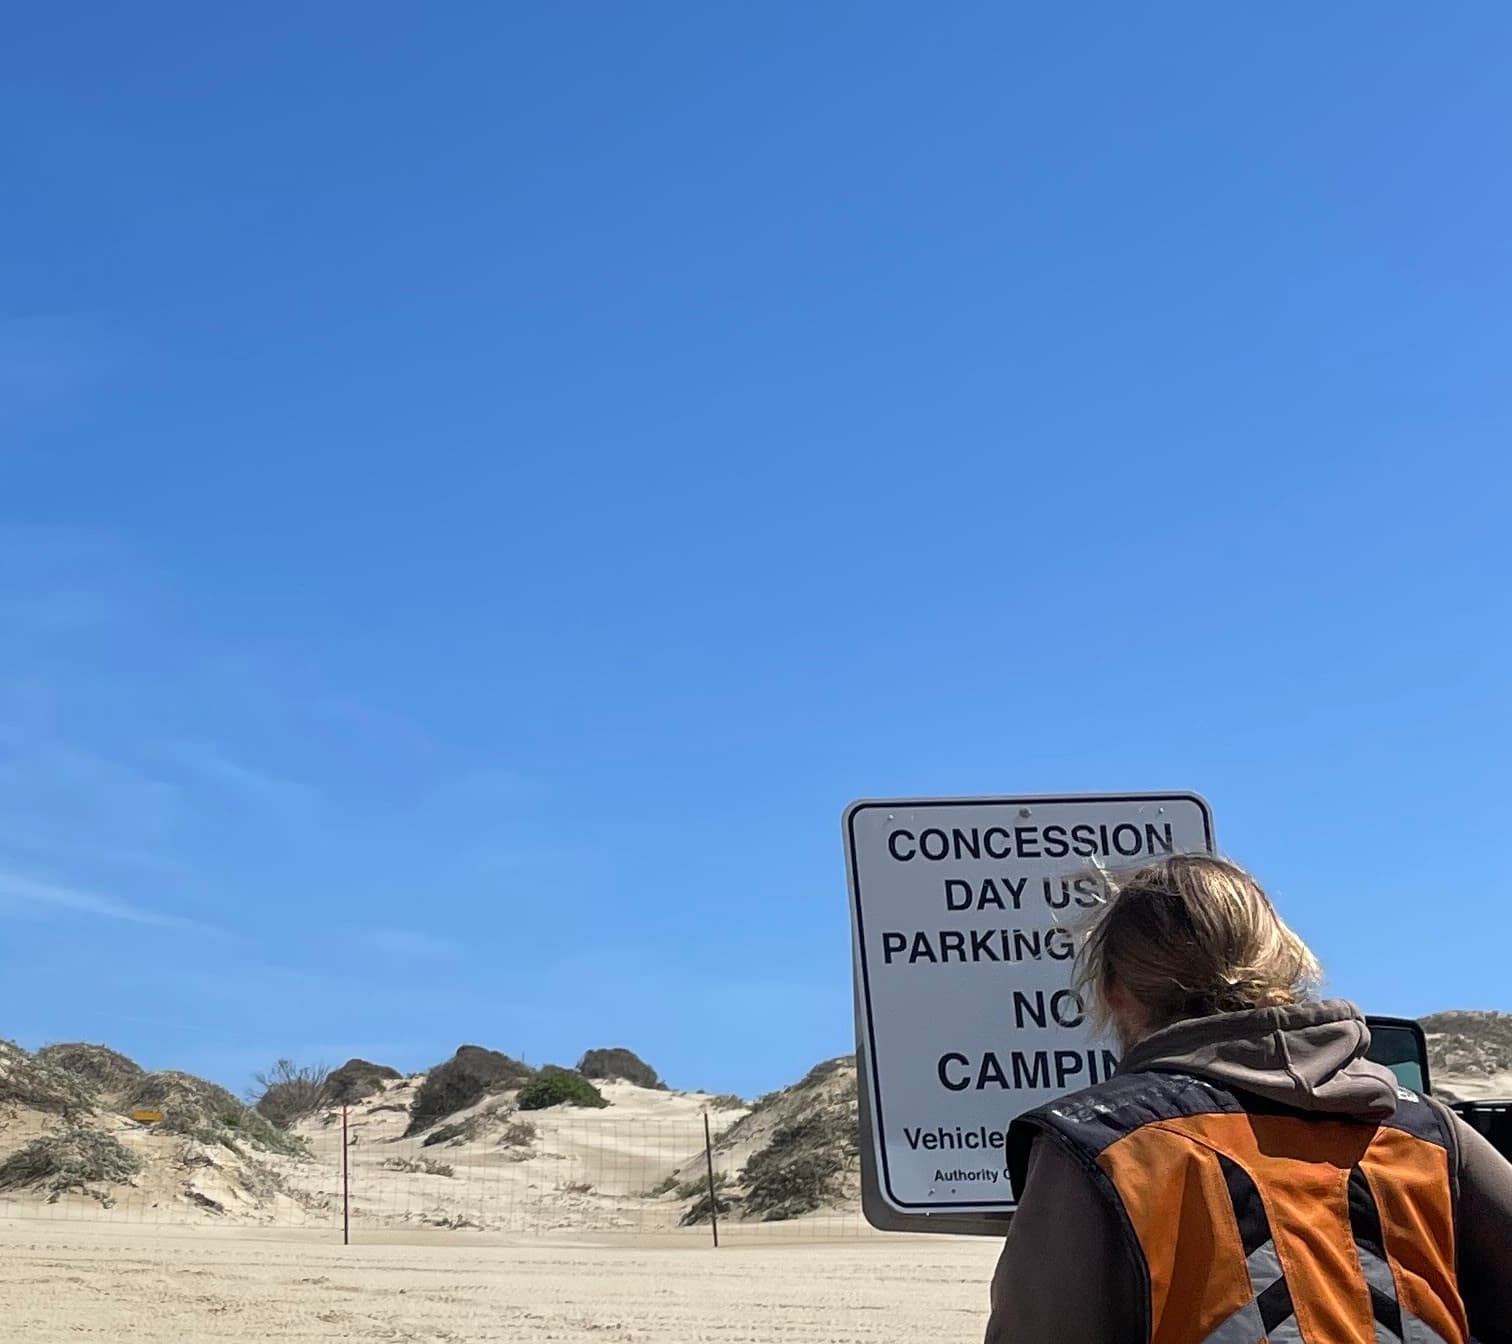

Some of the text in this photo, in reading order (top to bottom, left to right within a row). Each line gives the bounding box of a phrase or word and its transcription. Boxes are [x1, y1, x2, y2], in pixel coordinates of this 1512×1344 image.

[888, 822, 1174, 862] CONCESSION
[944, 875, 1103, 911] DAY US
[882, 926, 1076, 964] PARKING
[1012, 988, 1088, 1029] NO
[937, 1048, 1122, 1092] CAMPIN
[934, 1168, 999, 1184] Authority
